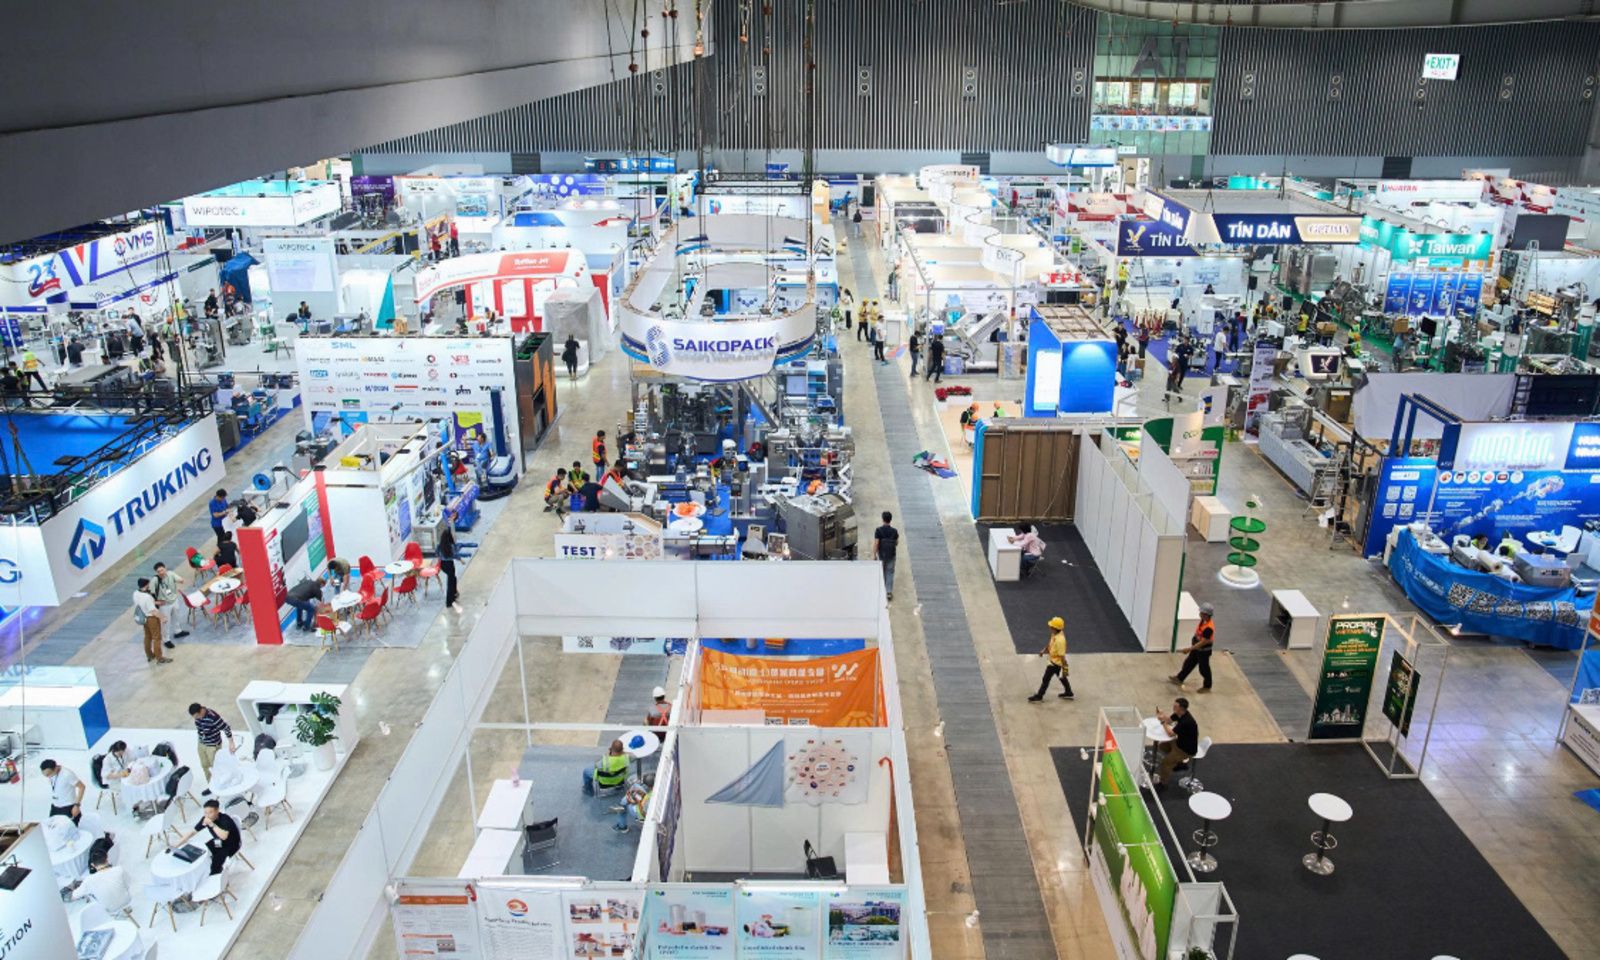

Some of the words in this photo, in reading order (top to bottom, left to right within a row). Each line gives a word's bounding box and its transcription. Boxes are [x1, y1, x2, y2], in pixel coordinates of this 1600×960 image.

[1430, 56, 1452, 69] EXIT
[1227, 221, 1254, 238] TÍN
[1256, 220, 1292, 239] DÂN
[126, 231, 155, 252] VMS
[1150, 233, 1174, 247] TÍN
[1427, 240, 1476, 255] Taiwan
[673, 336, 775, 352] SAIKOPACK
[107, 447, 212, 537] TRUKING
[561, 546, 596, 556] TEST
